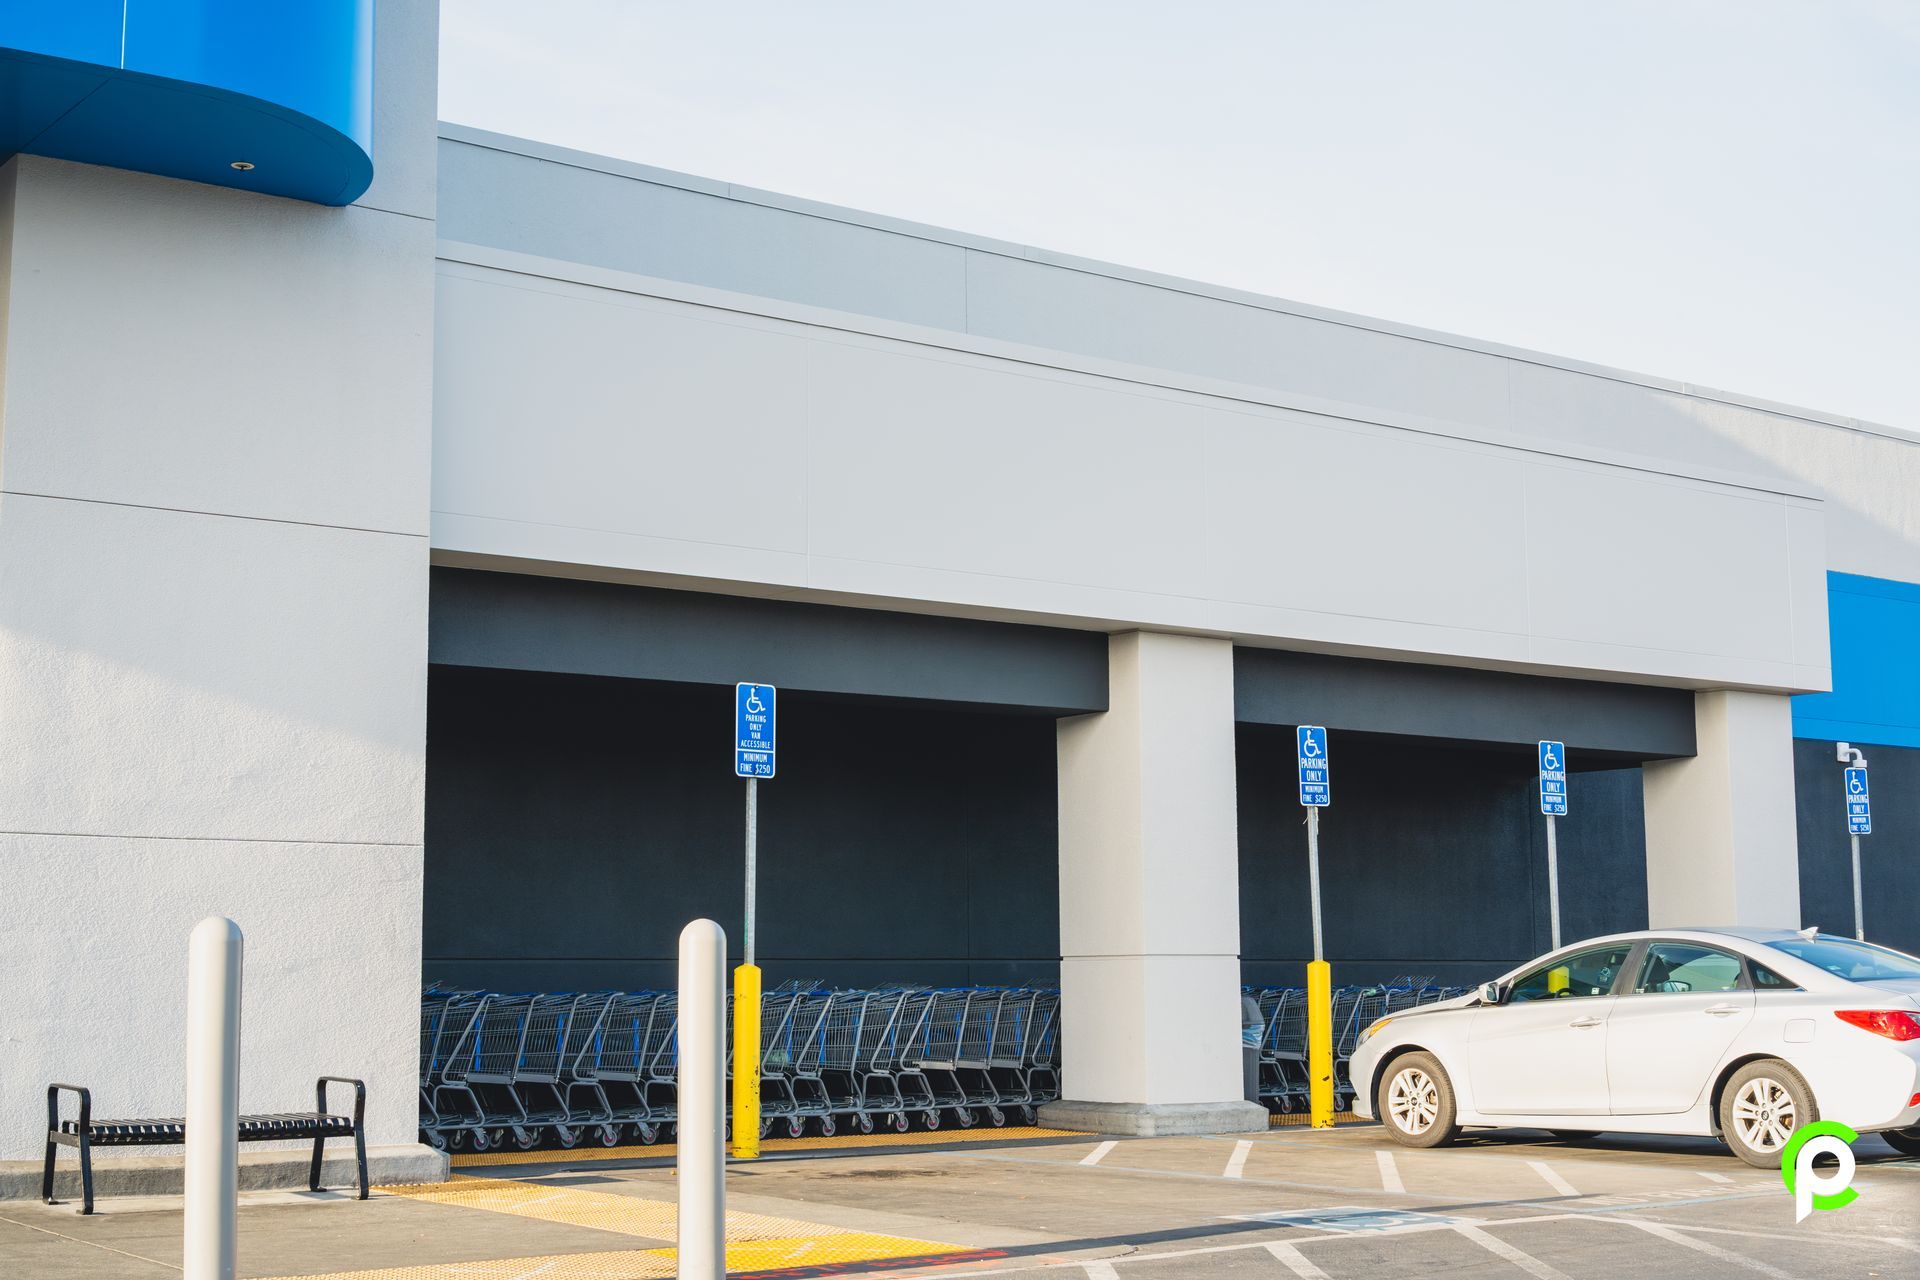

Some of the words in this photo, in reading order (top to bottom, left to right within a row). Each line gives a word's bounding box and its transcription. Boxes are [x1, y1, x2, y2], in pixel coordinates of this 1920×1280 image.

[745, 714, 767, 723] PARKING
[749, 723, 762, 731] ONLY
[751, 731, 761, 740] VAN
[740, 739, 771, 749] ACCESSIBLE
[743, 752, 768, 763] MINIMUM
[740, 763, 752, 773] FINE
[755, 764, 771, 775] $250
[1301, 757, 1327, 770] PARKING
[1306, 770, 1322, 782] ONLY
[1541, 770, 1564, 782] PARKING
[1546, 781, 1561, 793] ONLY
[1302, 794, 1313, 803] FINE
[1315, 794, 1328, 804] $250
